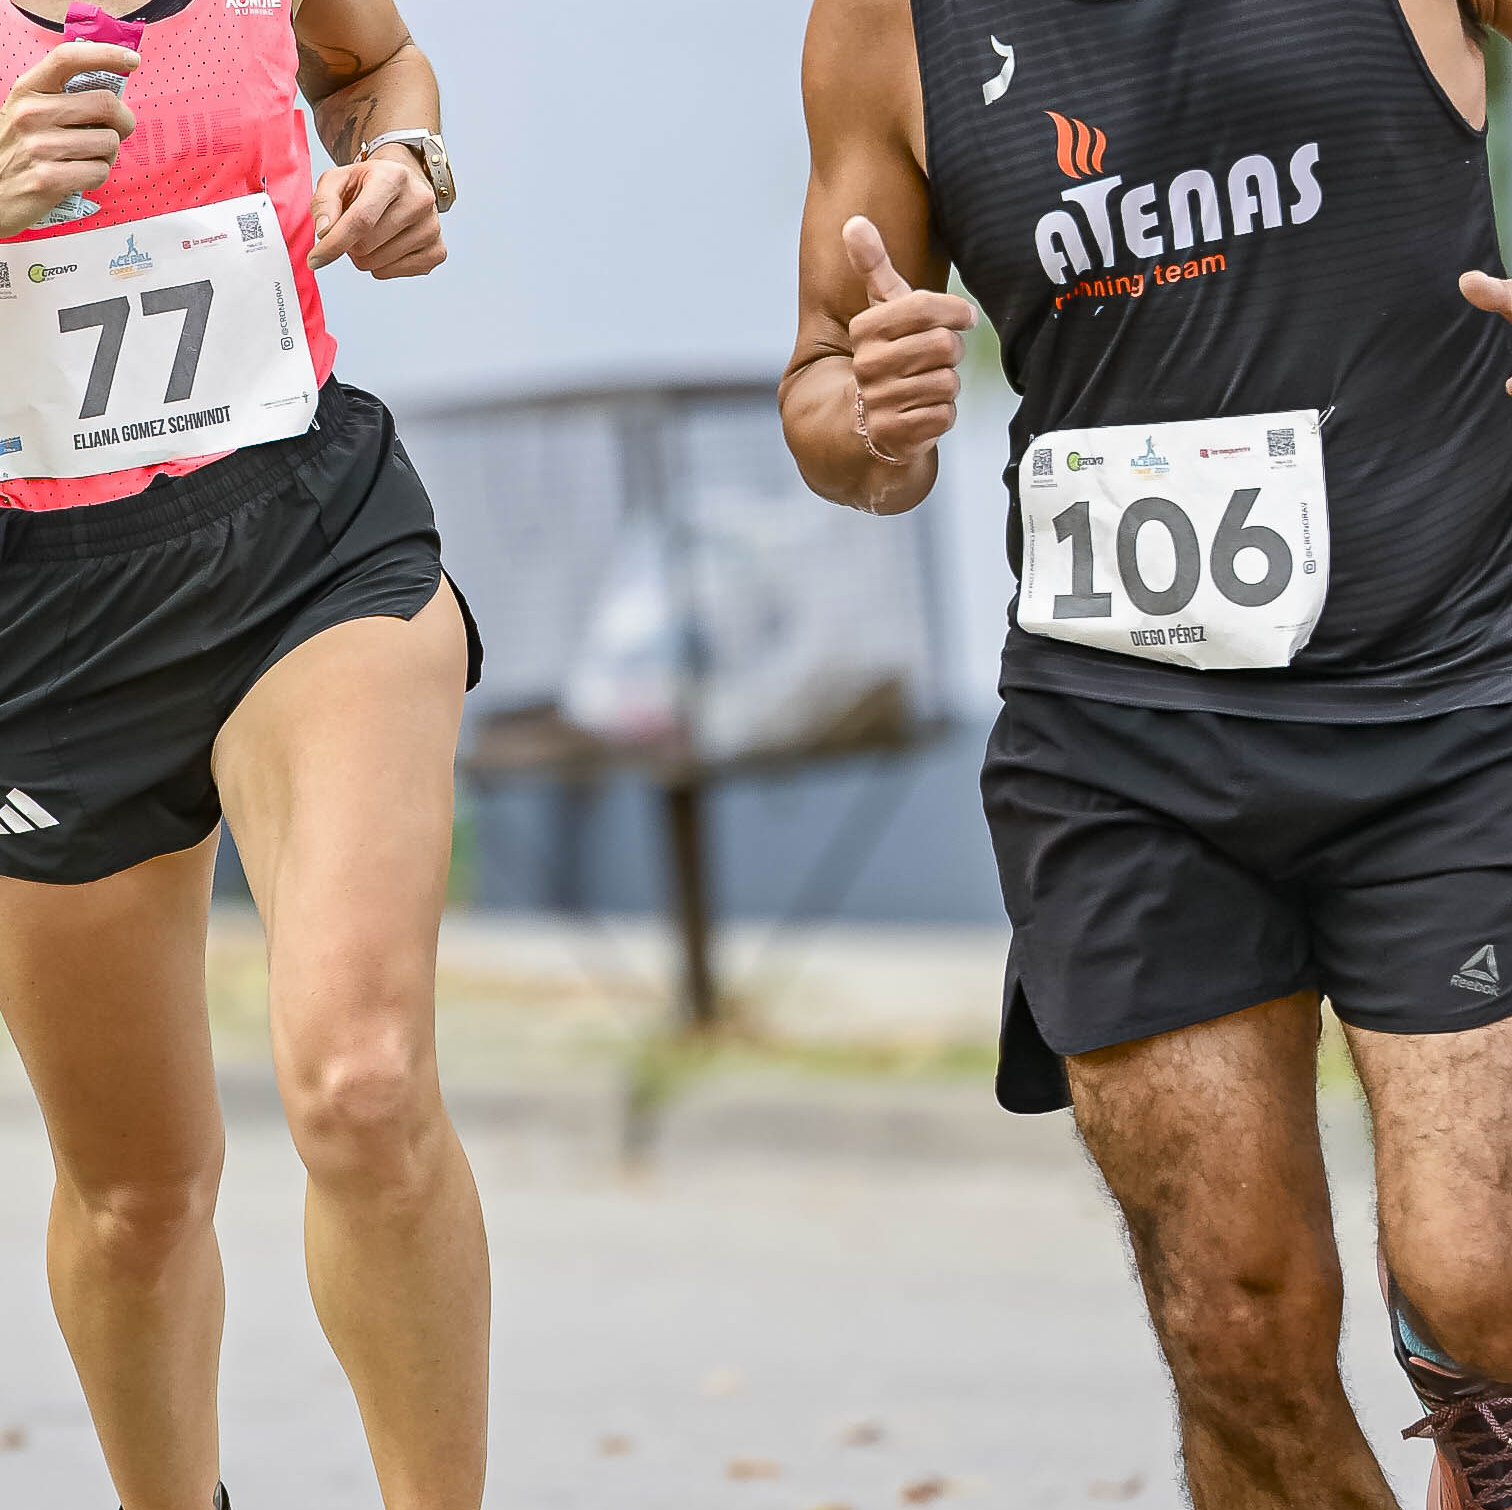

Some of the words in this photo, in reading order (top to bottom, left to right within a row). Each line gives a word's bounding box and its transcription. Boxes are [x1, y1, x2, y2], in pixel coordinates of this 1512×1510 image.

[1153, 252, 1226, 285] team
[58, 280, 215, 420] 77
[73, 427, 121, 450] ELIANA
[121, 418, 167, 442] GOMEZ
[168, 405, 232, 434] SCHWINDT
[1051, 487, 1294, 617] 106
[1130, 629, 1167, 646] DIEGO
[1168, 623, 1208, 645] PÉREZ
